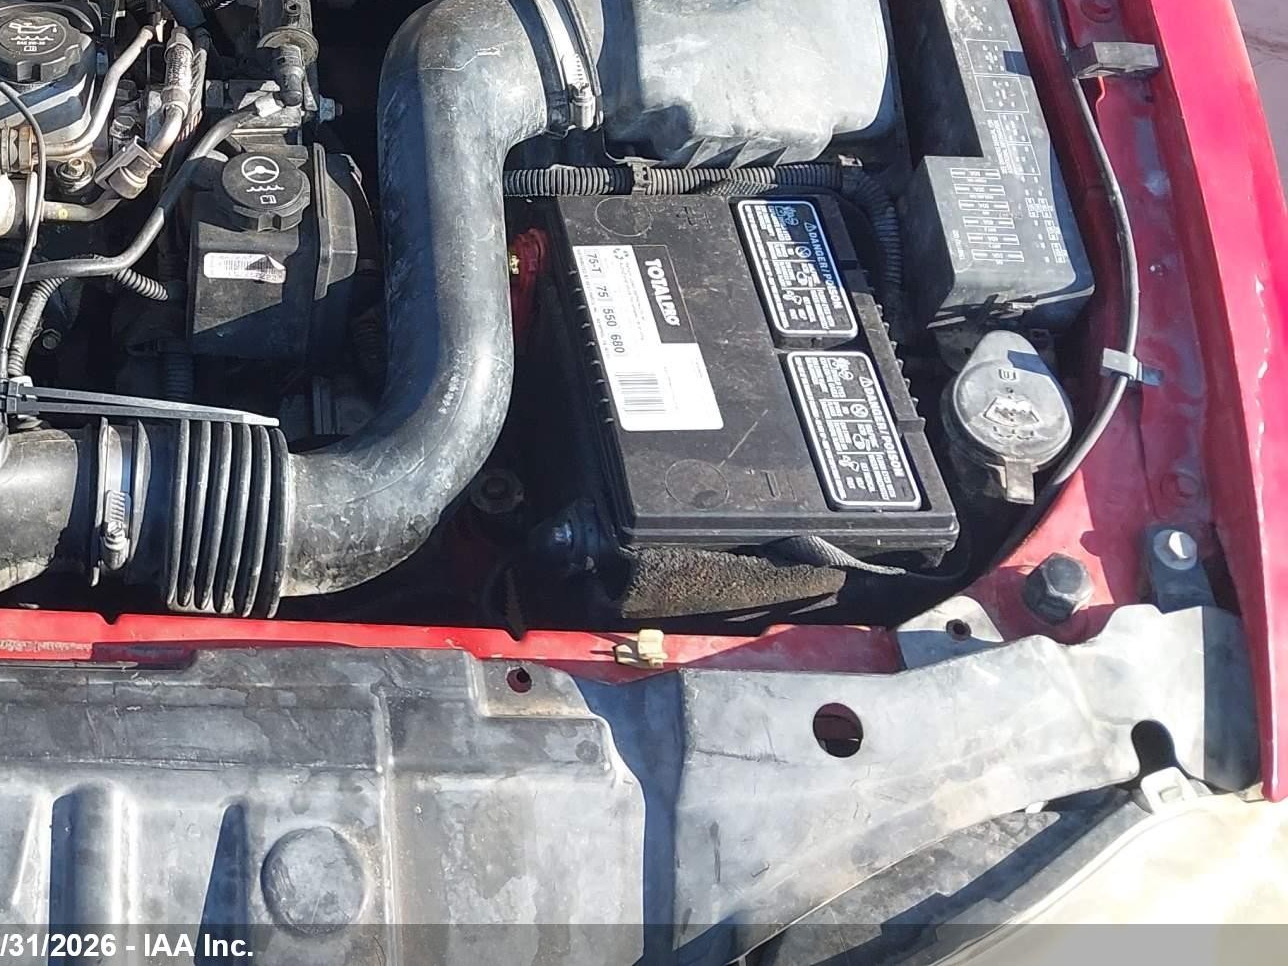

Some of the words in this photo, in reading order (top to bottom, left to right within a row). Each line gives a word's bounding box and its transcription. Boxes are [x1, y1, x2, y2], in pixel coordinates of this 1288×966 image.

[587, 253, 602, 274] 75-T
[597, 285, 609, 299] 75
[603, 308, 617, 327] 550
[611, 334, 625, 353] 680
[644, 258, 681, 327] TOTALPRO
[863, 386, 905, 477] DANGER/POISON
